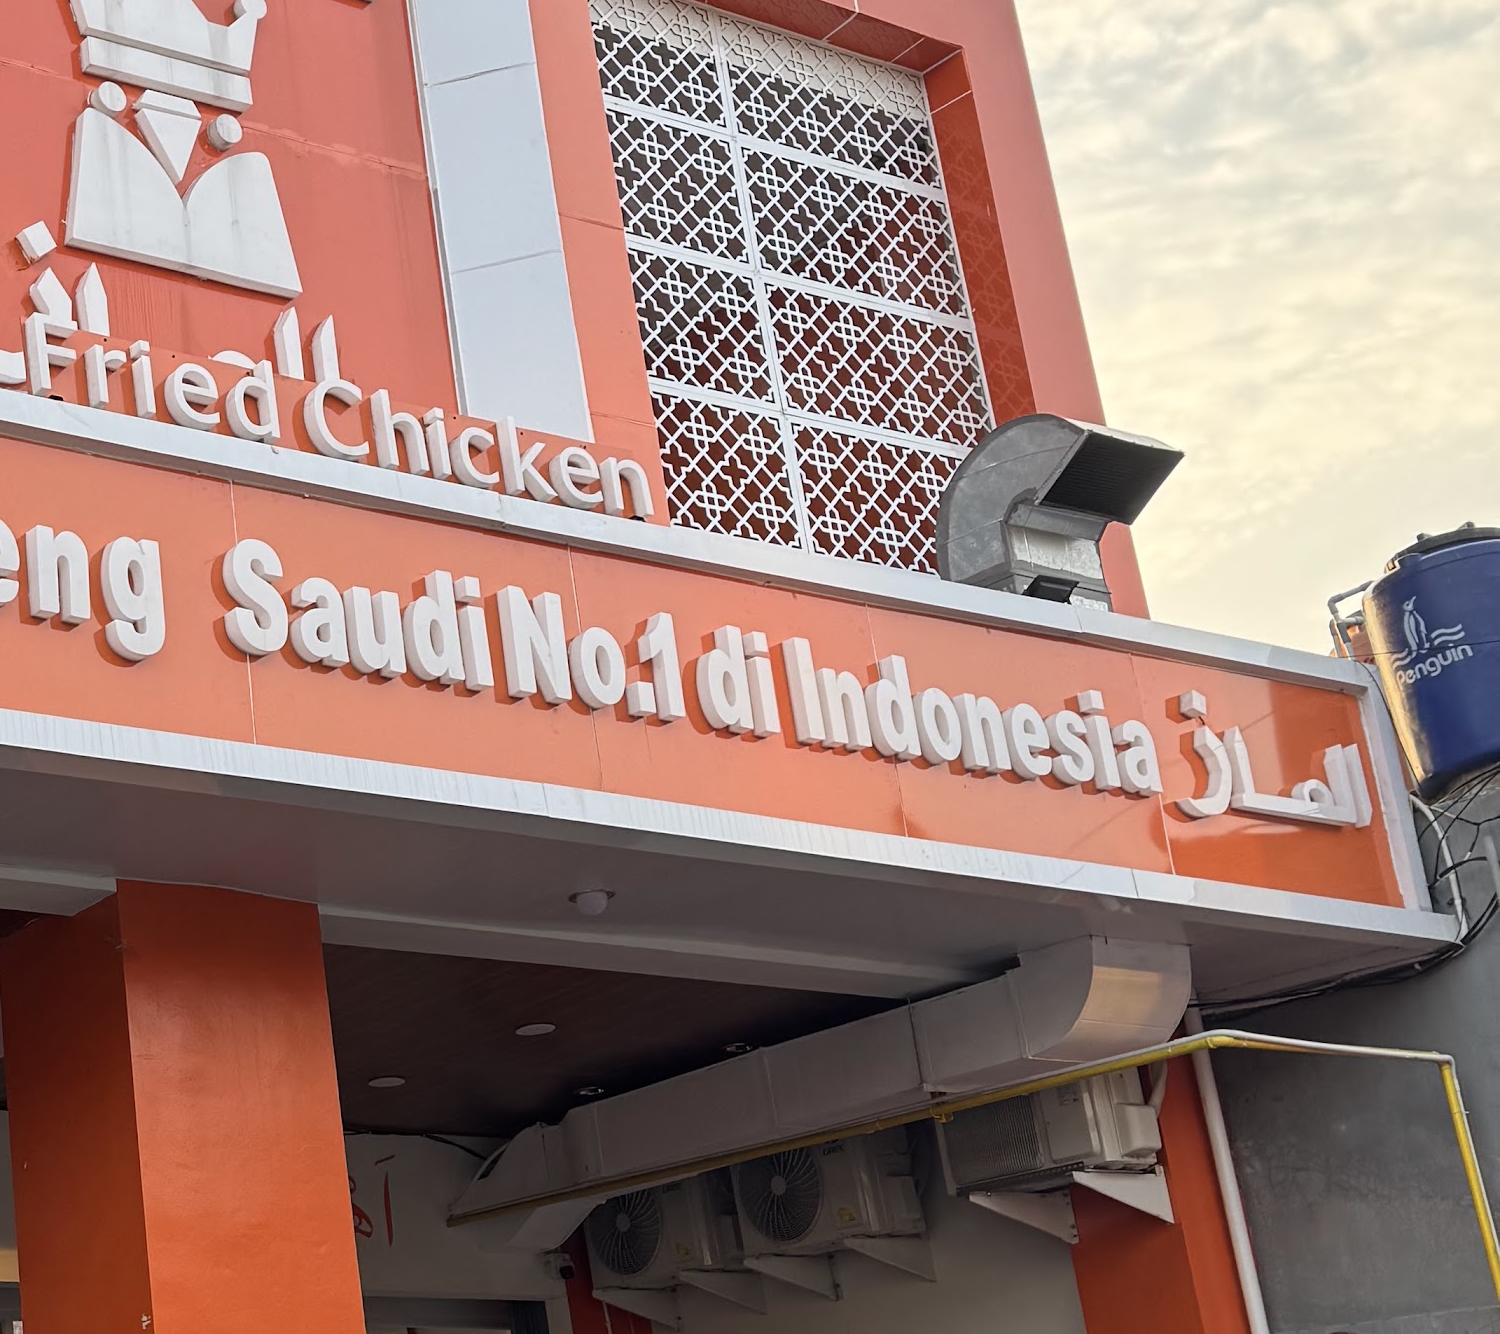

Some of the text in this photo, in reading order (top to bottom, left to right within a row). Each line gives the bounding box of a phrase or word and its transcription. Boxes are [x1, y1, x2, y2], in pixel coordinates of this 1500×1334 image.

[24, 312, 654, 519] Fried Chicken
[222, 538, 495, 692] Saudi
[497, 585, 686, 722] No.1
[696, 624, 781, 739] di
[782, 636, 1163, 798] Indonesia
[1396, 643, 1474, 687] Penguin
[1176, 689, 1374, 829] الماز
